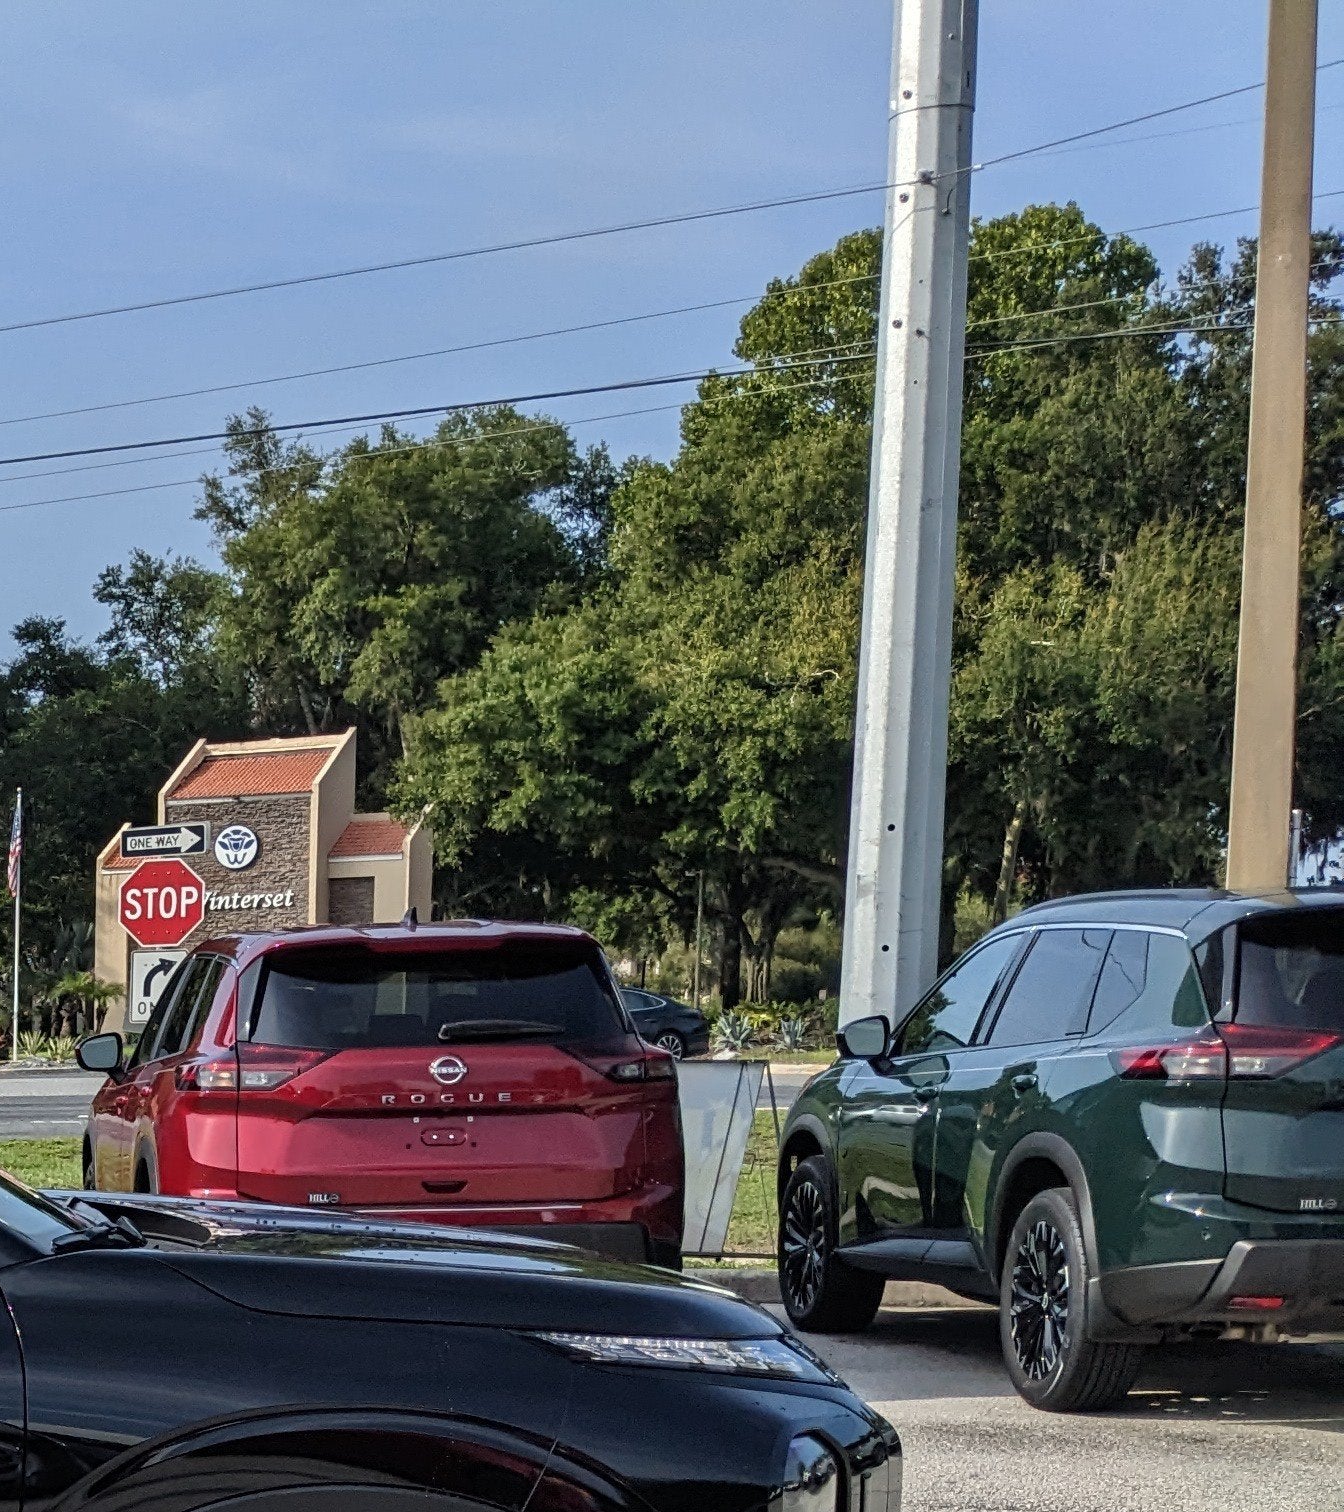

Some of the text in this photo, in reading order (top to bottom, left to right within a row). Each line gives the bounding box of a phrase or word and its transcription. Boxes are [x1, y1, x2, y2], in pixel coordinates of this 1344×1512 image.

[129, 834, 180, 850] ONE WAY
[124, 886, 199, 921] STOP
[429, 1066, 468, 1074] NISSAN
[381, 1092, 512, 1105] ROGUE
